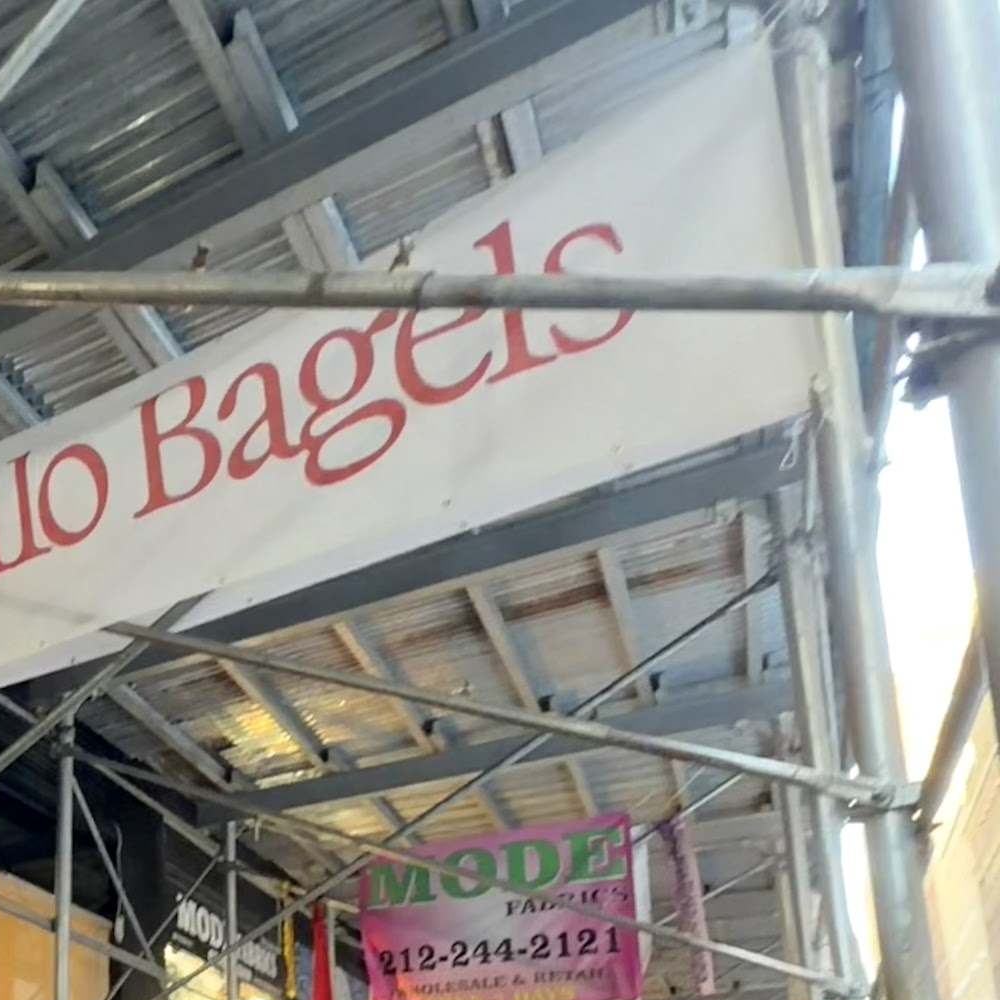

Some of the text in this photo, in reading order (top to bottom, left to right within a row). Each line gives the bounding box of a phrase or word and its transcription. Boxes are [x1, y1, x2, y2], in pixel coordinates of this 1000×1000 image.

[132, 220, 635, 519] Bagels
[366, 825, 627, 911] MODE
[380, 926, 621, 976] 212-244-2121
[398, 974, 506, 998] OLESALE
[511, 973, 527, 986] &
